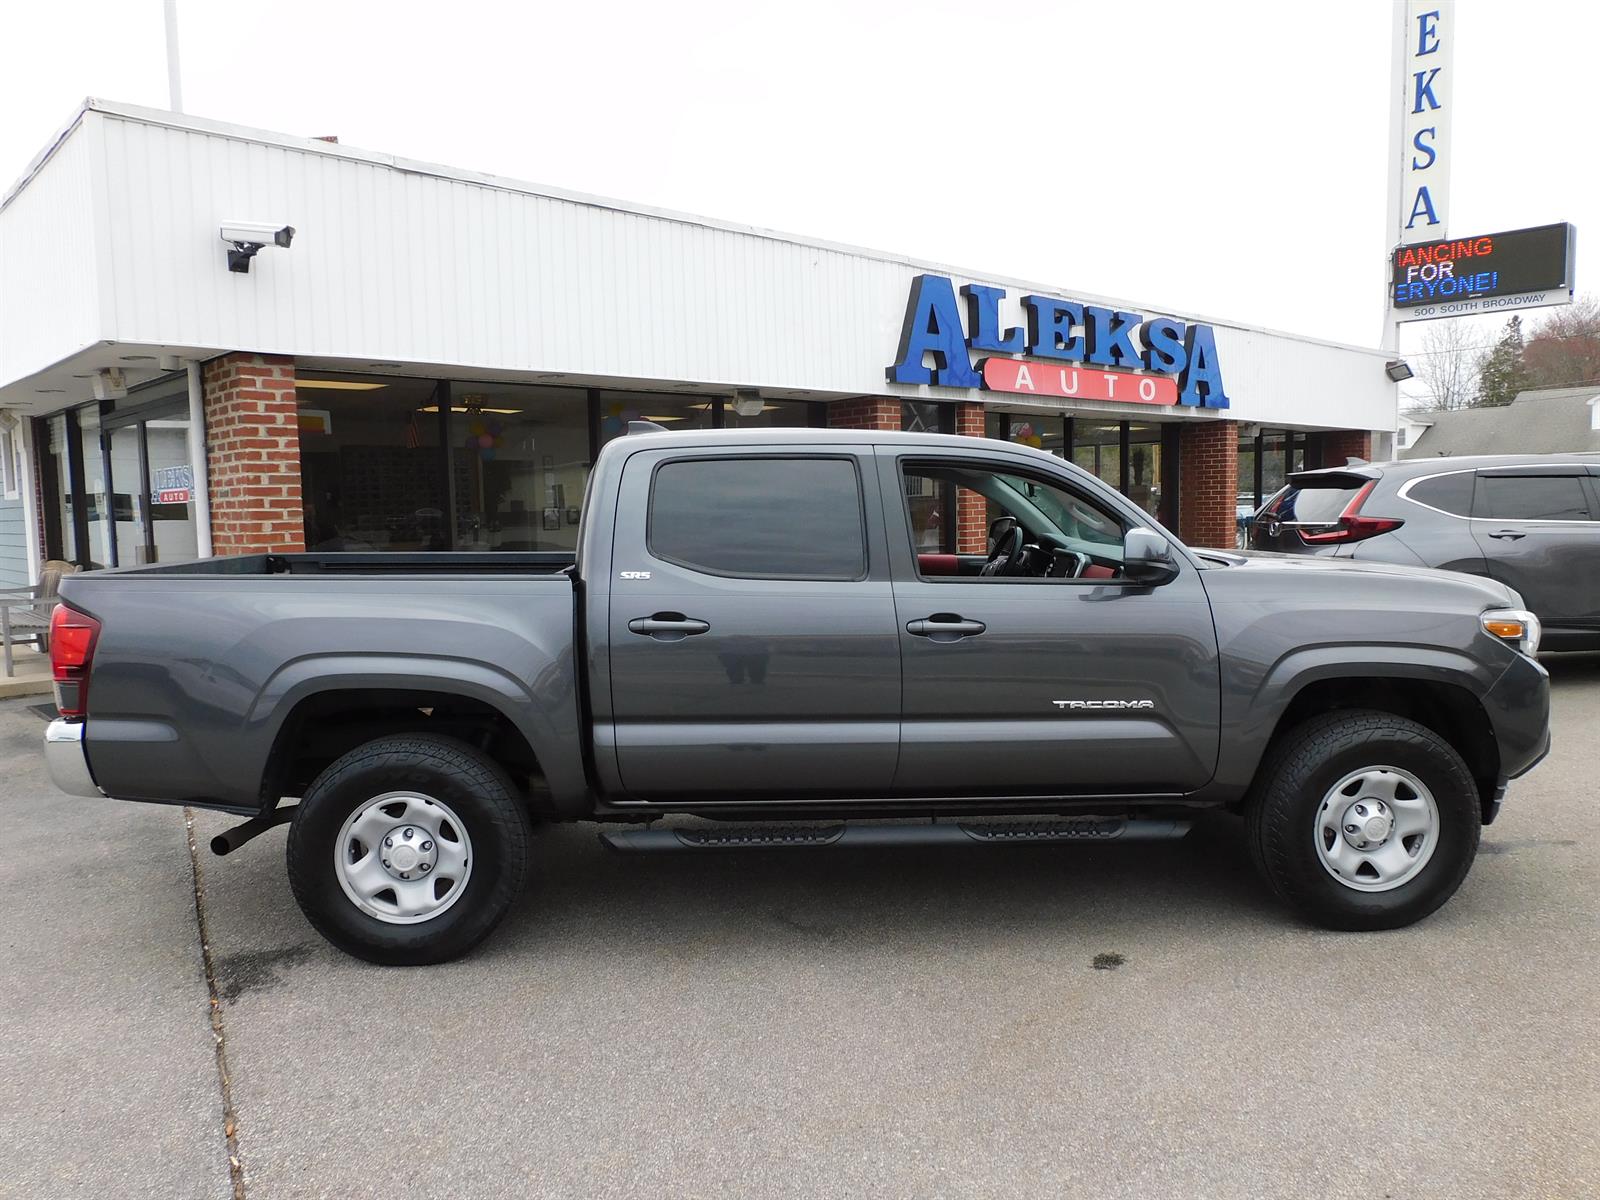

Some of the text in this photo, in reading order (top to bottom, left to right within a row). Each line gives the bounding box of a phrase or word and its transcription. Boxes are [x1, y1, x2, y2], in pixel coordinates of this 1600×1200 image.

[1407, 261, 1455, 284] FOR
[1414, 293, 1547, 317] 500 SOUTH BROADWAY
[885, 274, 1230, 409] ALEKSA
[1014, 365, 1156, 401] AUTO
[163, 492, 184, 501] AUTO
[1052, 700, 1155, 709] TACOMA
